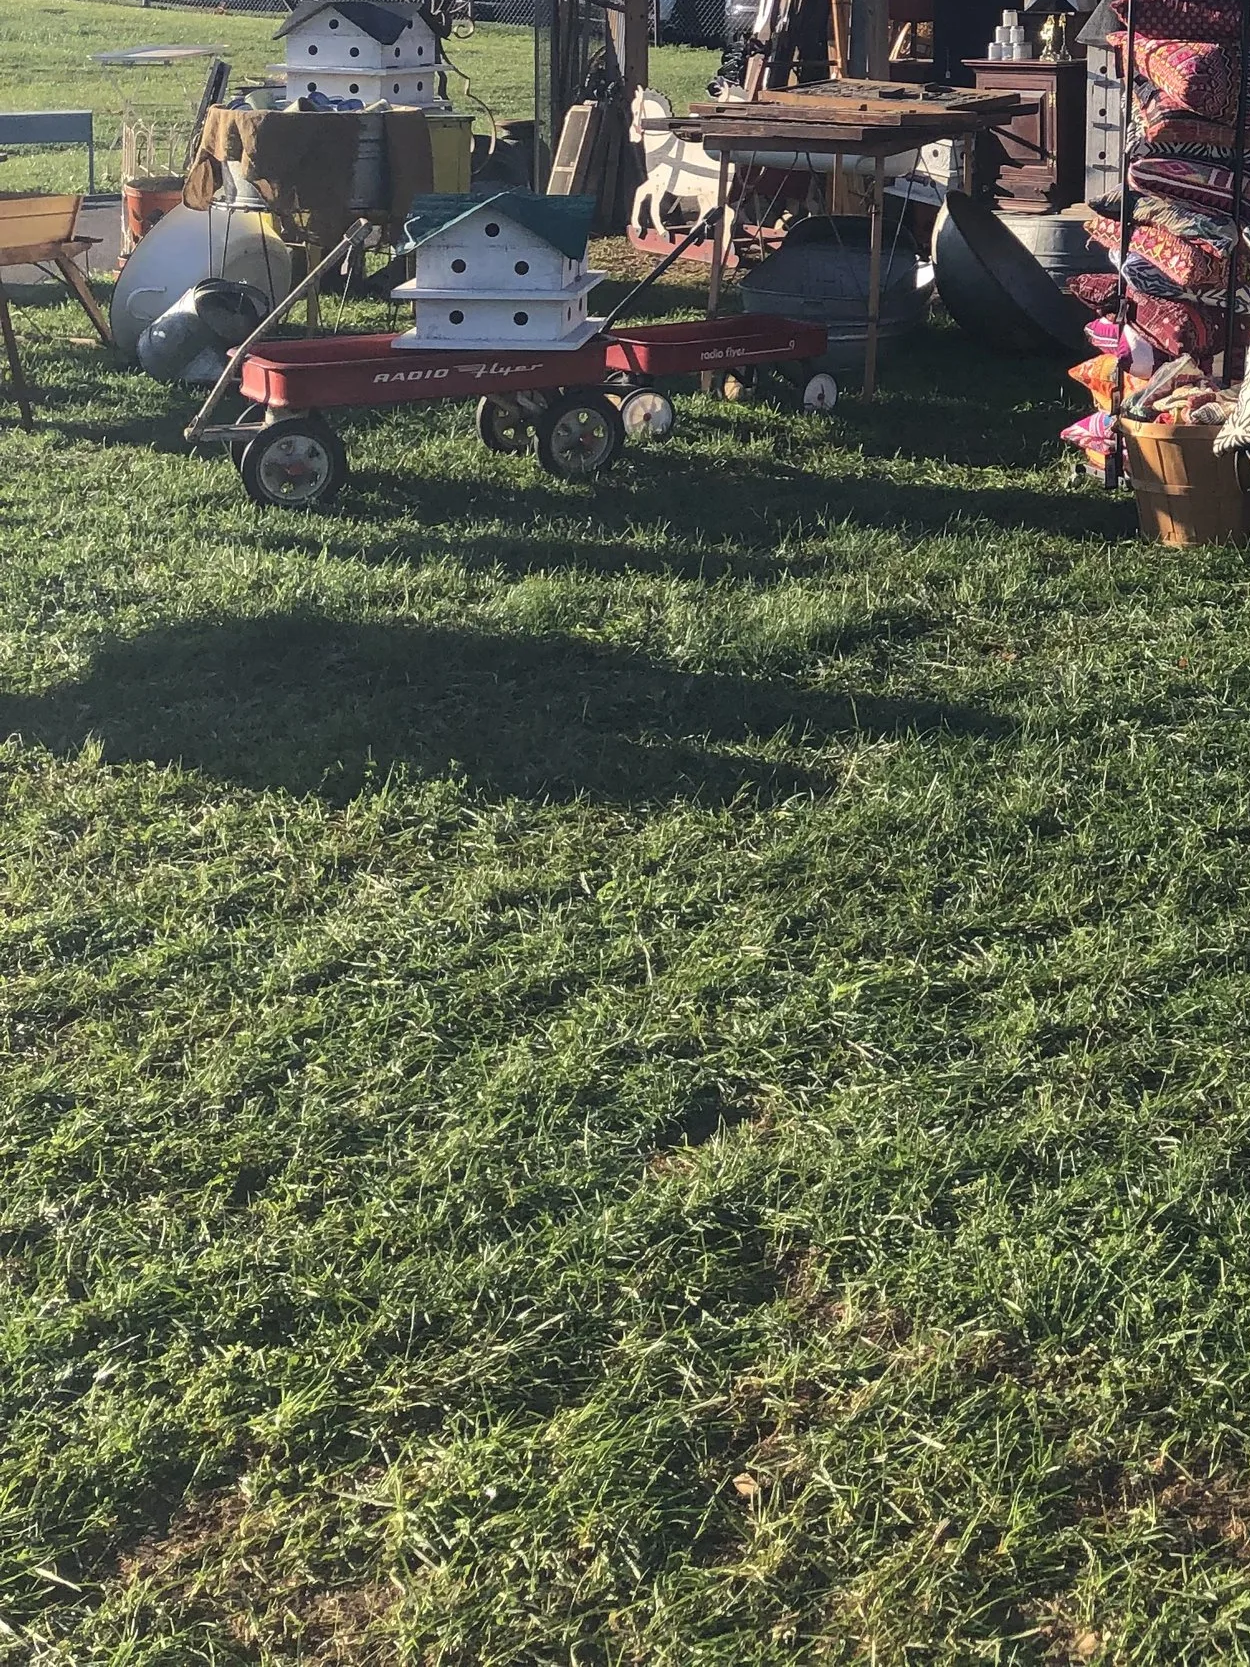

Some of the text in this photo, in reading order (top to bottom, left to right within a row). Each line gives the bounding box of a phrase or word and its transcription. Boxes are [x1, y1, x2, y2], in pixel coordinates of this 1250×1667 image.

[700, 348, 724, 361] radio
[725, 346, 747, 359] flyer
[373, 368, 450, 383] RADIO
